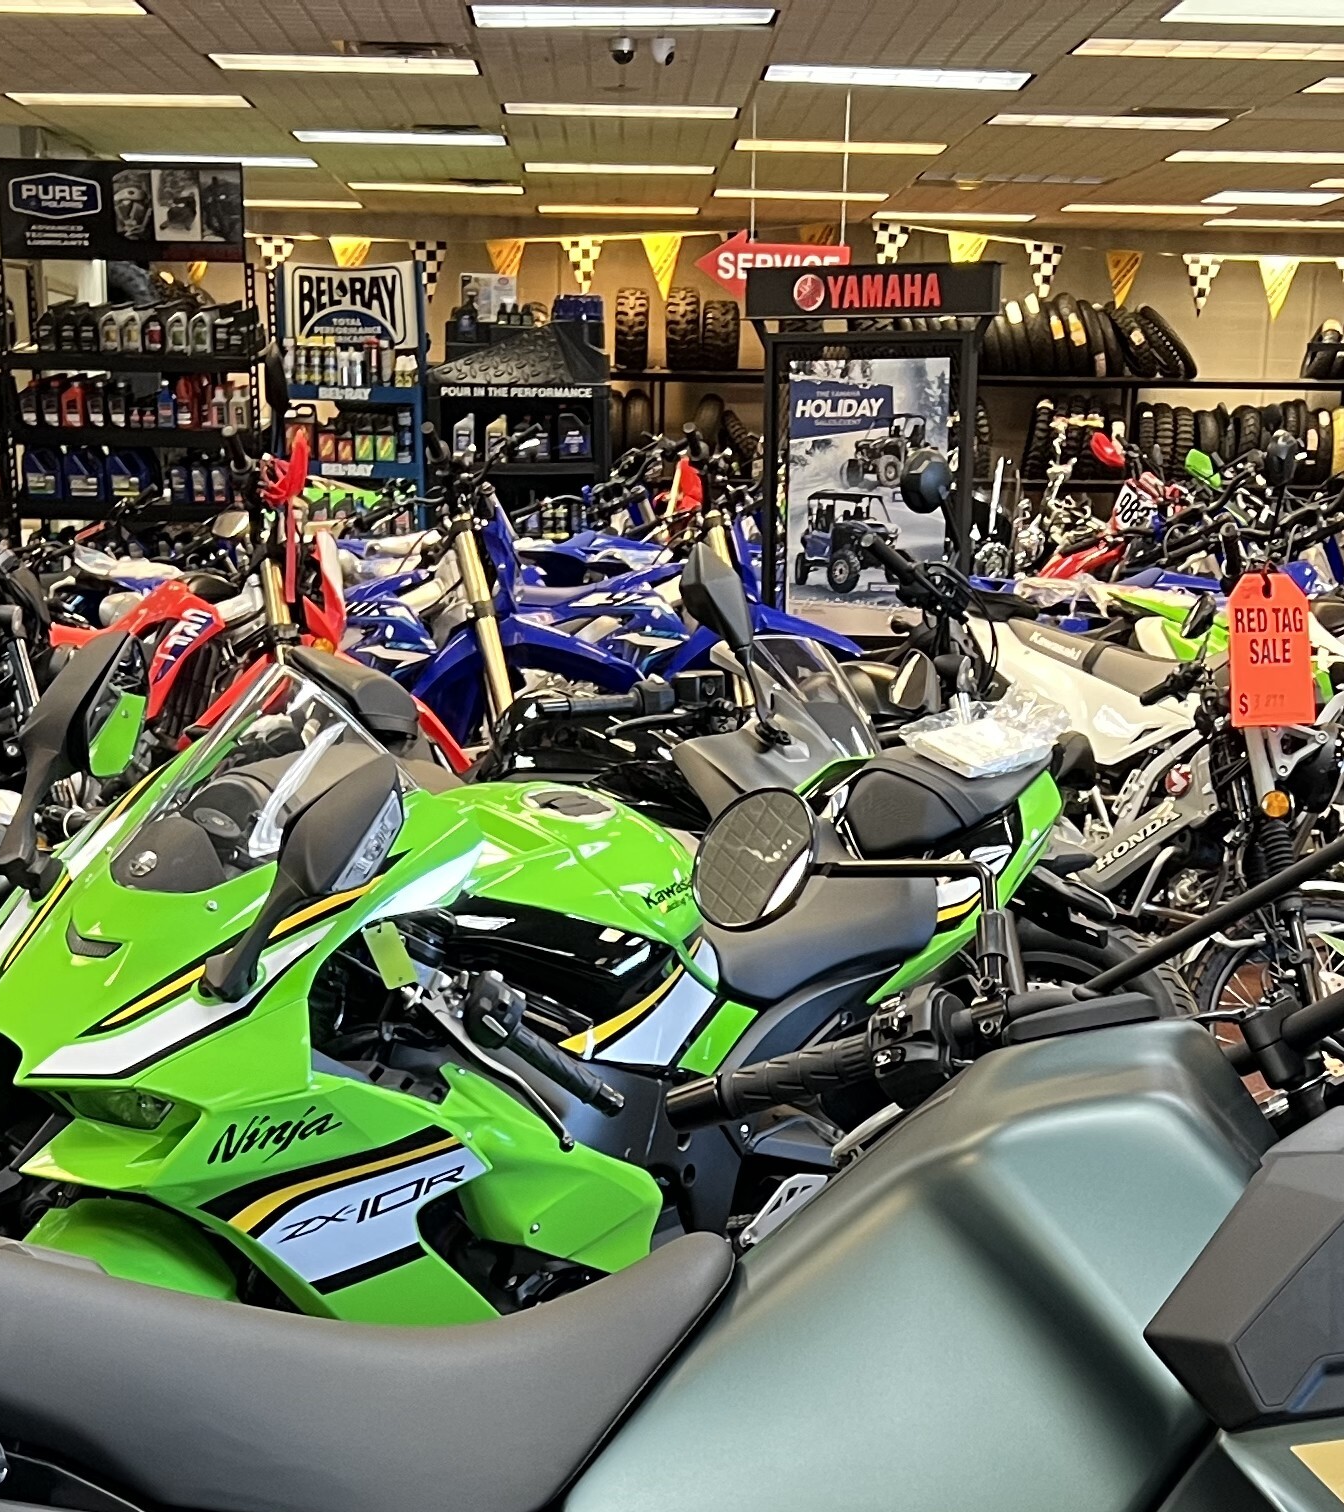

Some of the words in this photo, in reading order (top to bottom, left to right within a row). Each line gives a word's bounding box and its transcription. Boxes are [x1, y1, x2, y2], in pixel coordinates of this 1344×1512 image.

[21, 184, 88, 201] PURE
[826, 272, 942, 309] YAMAHA
[440, 386, 472, 397] POUR
[474, 387, 485, 397] IN
[487, 387, 508, 397] THE
[510, 387, 593, 398] PERFORMANCE
[795, 398, 885, 418] HOLIDAY
[1234, 607, 1268, 634] RED
[1272, 606, 1304, 632] TAG
[1249, 638, 1292, 665] SALE
[1238, 692, 1249, 715] $
[1096, 809, 1183, 873] HONDA
[207, 1105, 343, 1165] Ninja
[276, 1164, 466, 1245] ZX-10R
